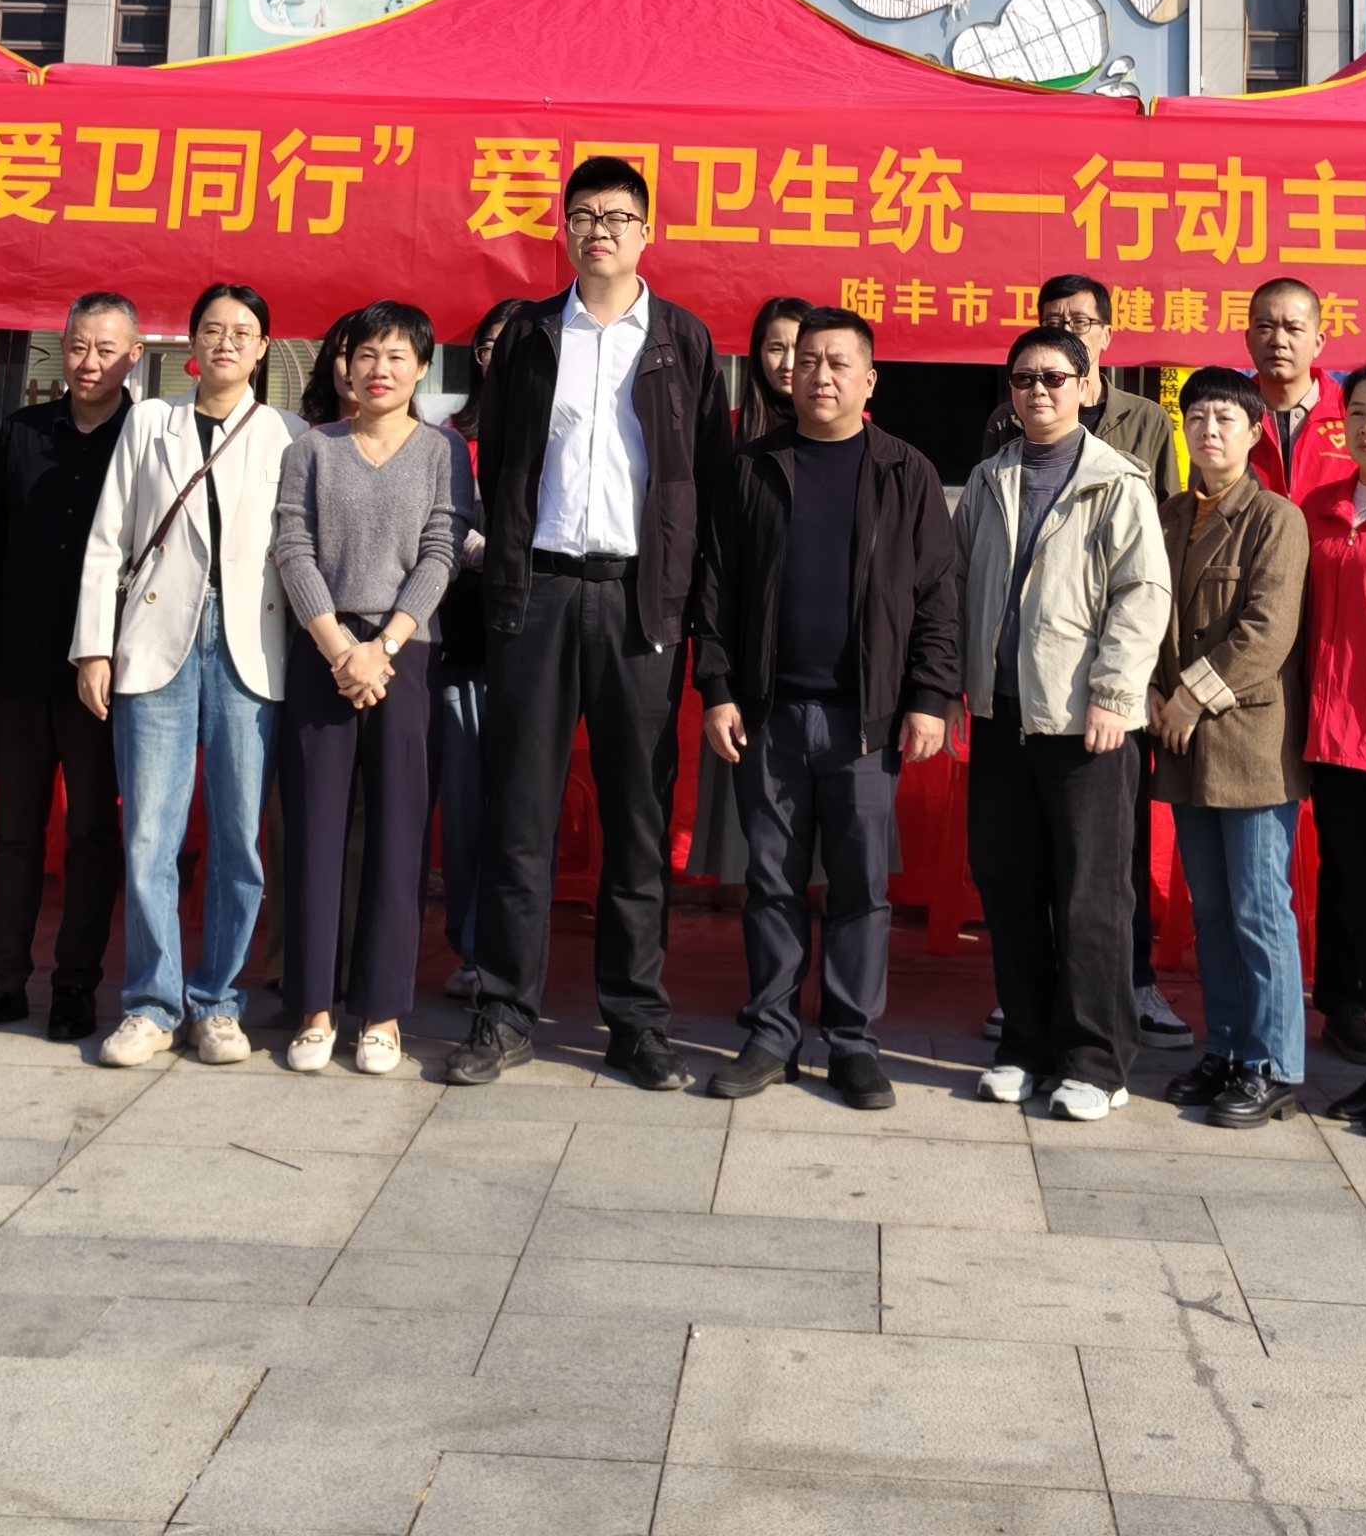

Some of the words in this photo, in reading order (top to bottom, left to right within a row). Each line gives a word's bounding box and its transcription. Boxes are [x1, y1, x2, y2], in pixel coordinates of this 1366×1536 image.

[839, 277, 1252, 336] 陆丰市卫健康局
